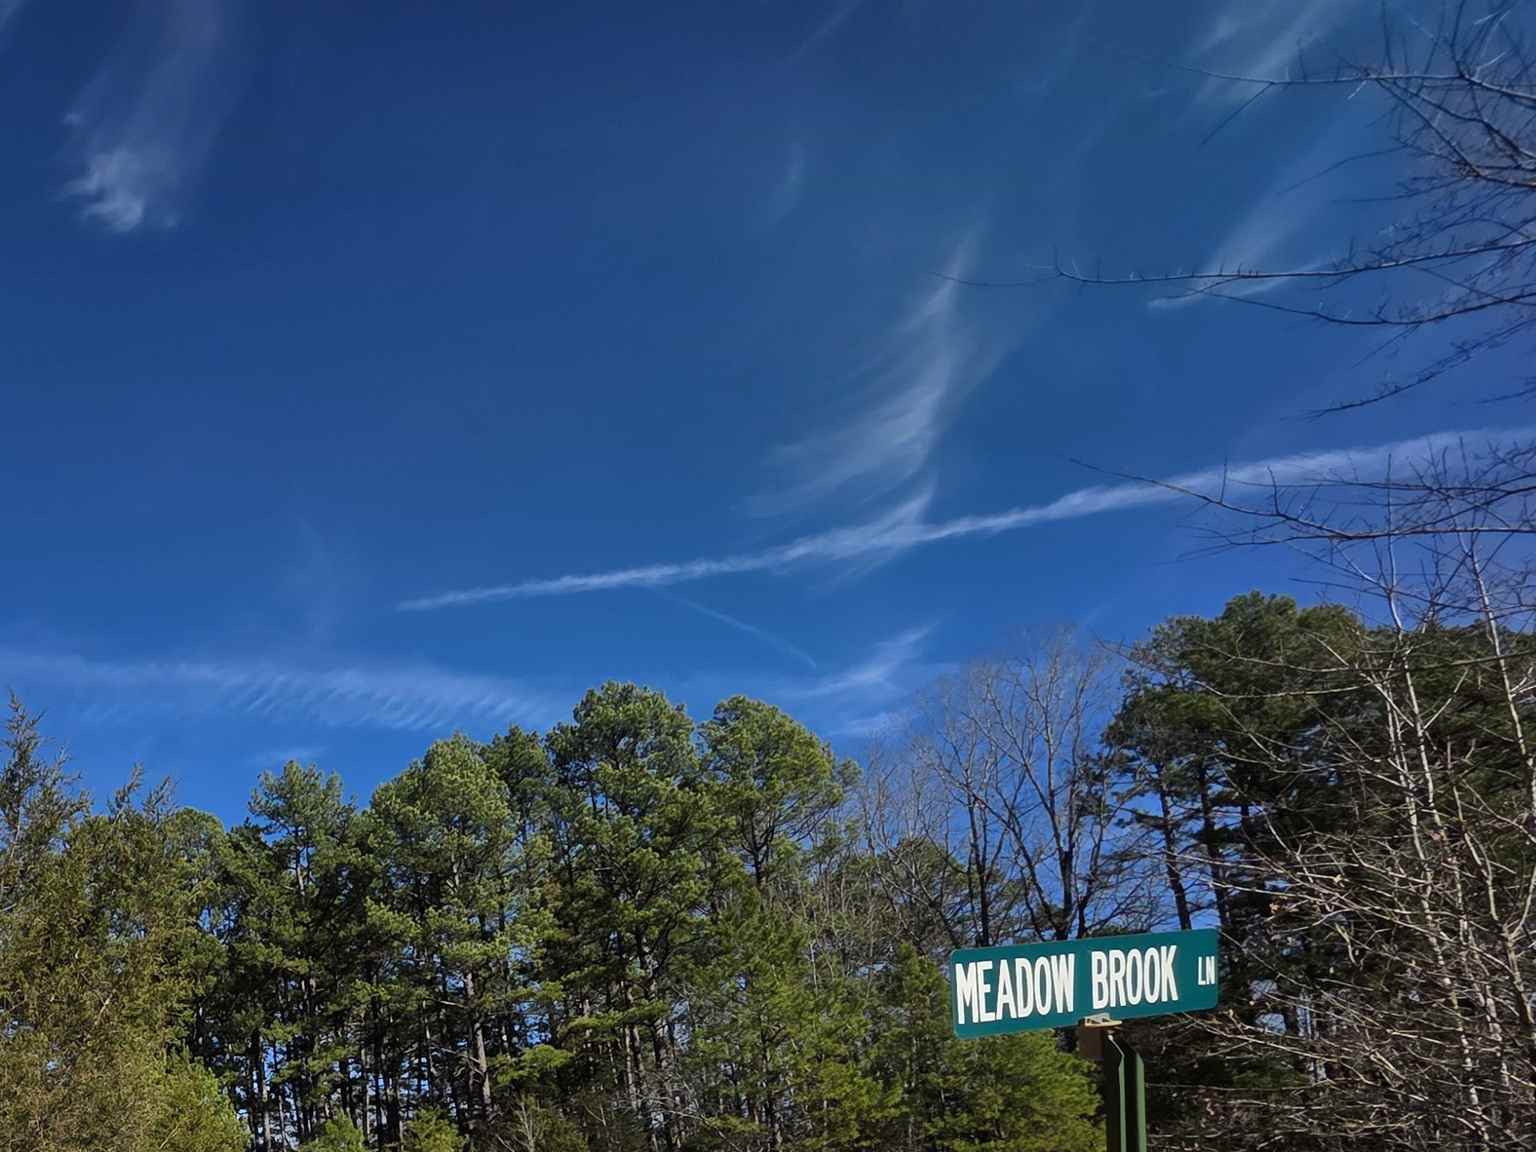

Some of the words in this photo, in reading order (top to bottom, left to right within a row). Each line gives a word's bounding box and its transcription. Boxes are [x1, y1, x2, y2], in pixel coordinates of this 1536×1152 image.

[955, 953, 1076, 1025] MEADOW
[1091, 945, 1179, 1010] BROOK
[1197, 955, 1216, 986] LN
